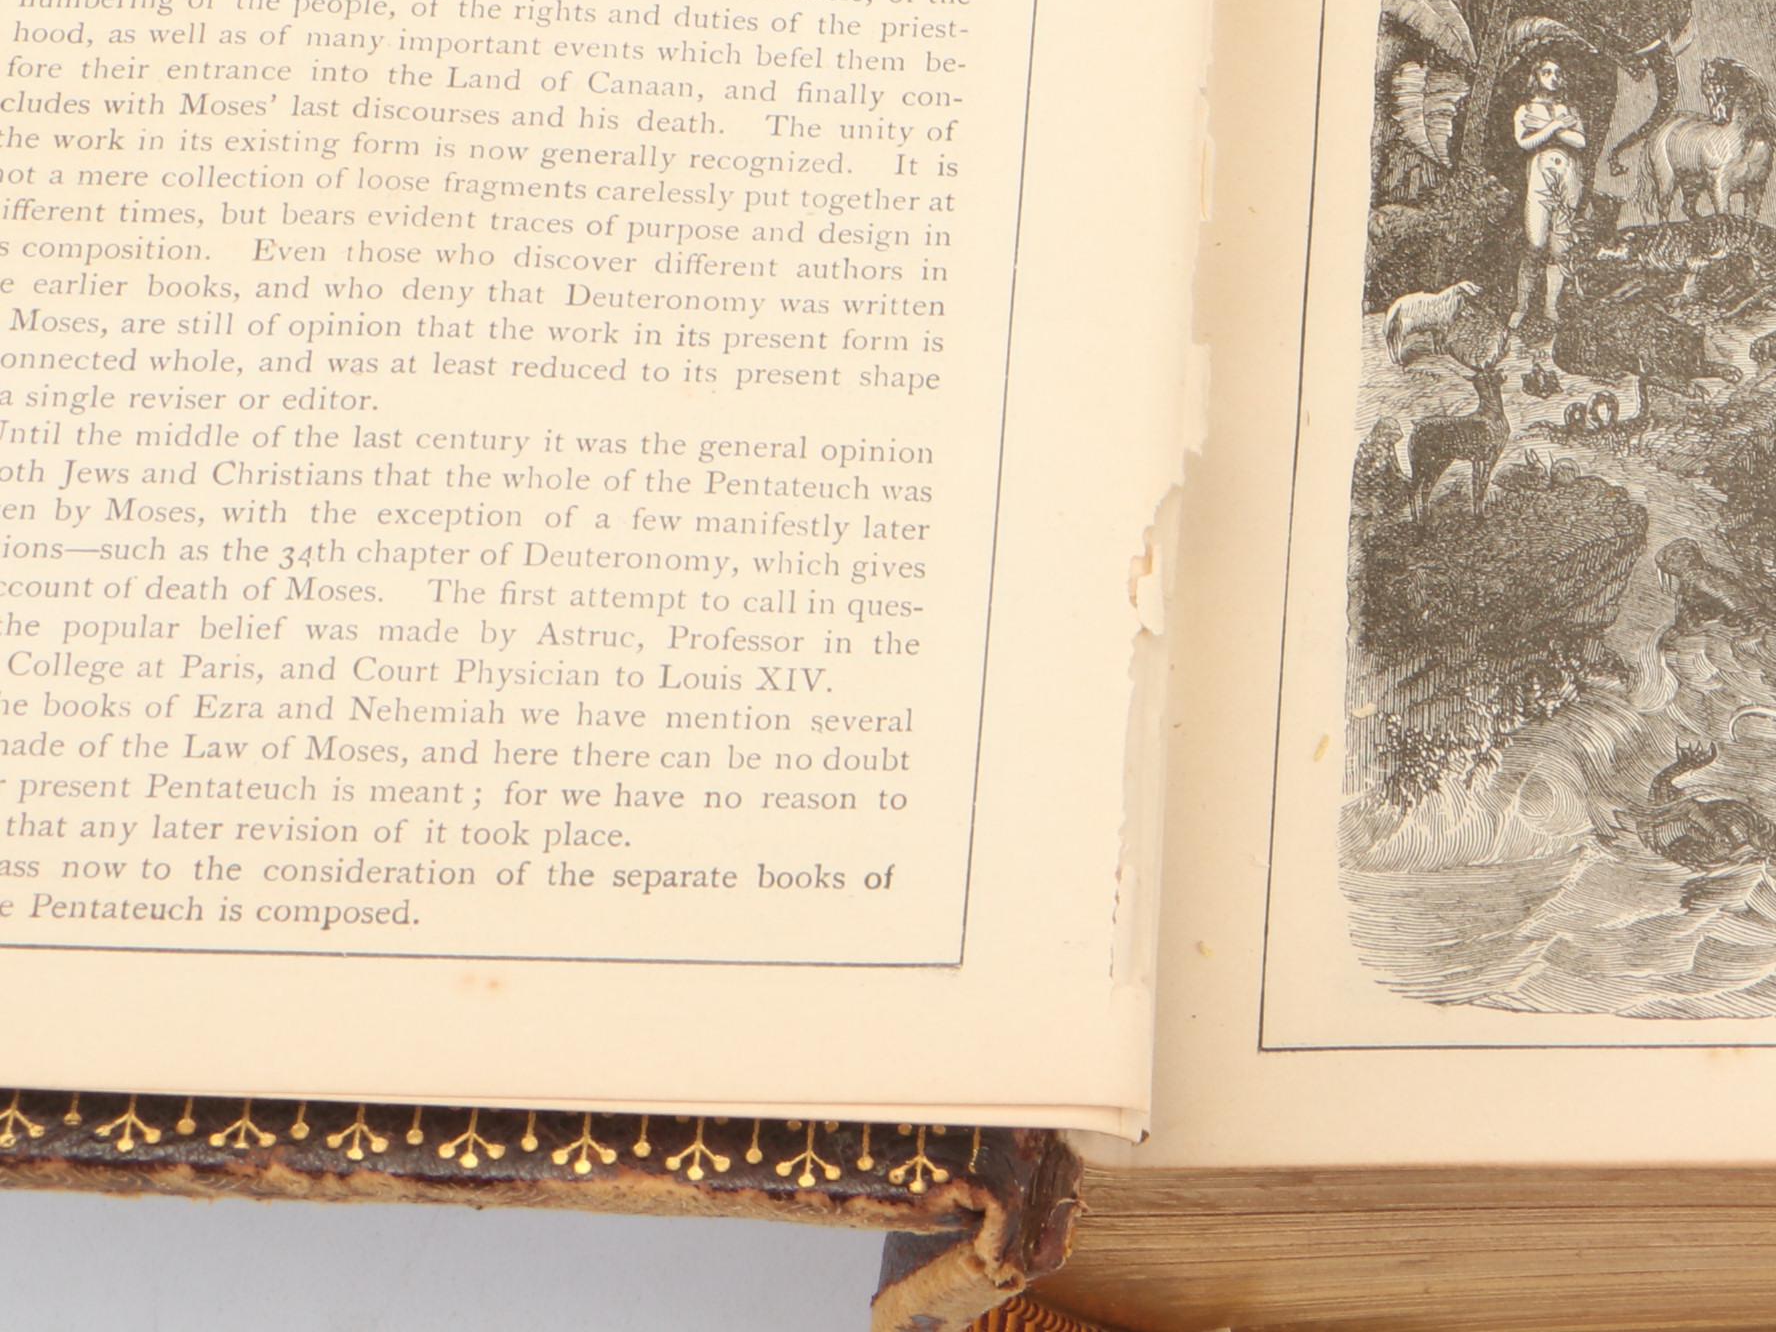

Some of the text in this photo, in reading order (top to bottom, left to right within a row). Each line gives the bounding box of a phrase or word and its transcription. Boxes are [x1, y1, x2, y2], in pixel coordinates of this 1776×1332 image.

[7, 651, 833, 693] College at Paris, and Court Physician to Louis XIV.
[61, 854, 896, 894] now to the consideration of the separate books of
[28, 893, 420, 931] Pentateuch is composed.
